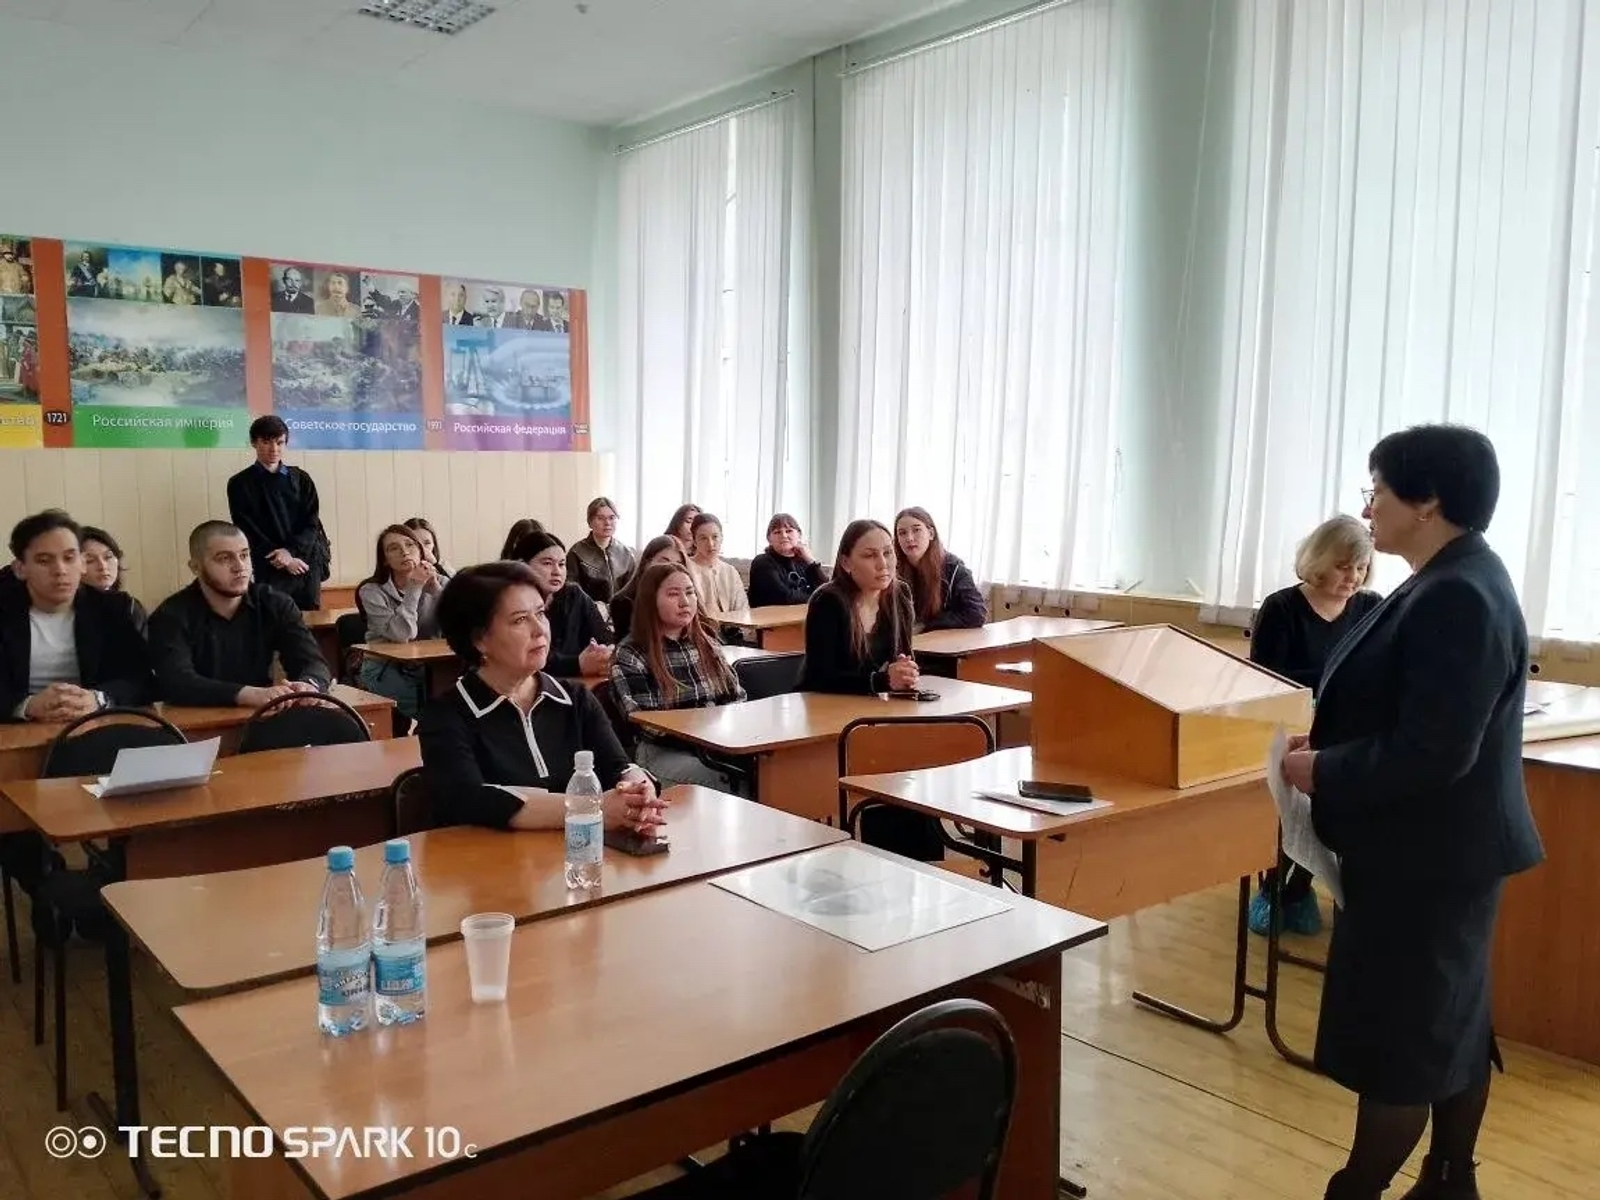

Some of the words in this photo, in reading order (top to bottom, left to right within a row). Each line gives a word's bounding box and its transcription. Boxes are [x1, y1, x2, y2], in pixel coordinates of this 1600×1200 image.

[46, 412, 67, 423] 1721
[92, 413, 172, 428] Российская
[175, 416, 234, 431] империя
[285, 418, 346, 432] Советское
[349, 420, 417, 434] государство
[453, 422, 511, 434] Российская
[512, 423, 566, 436] федерация
